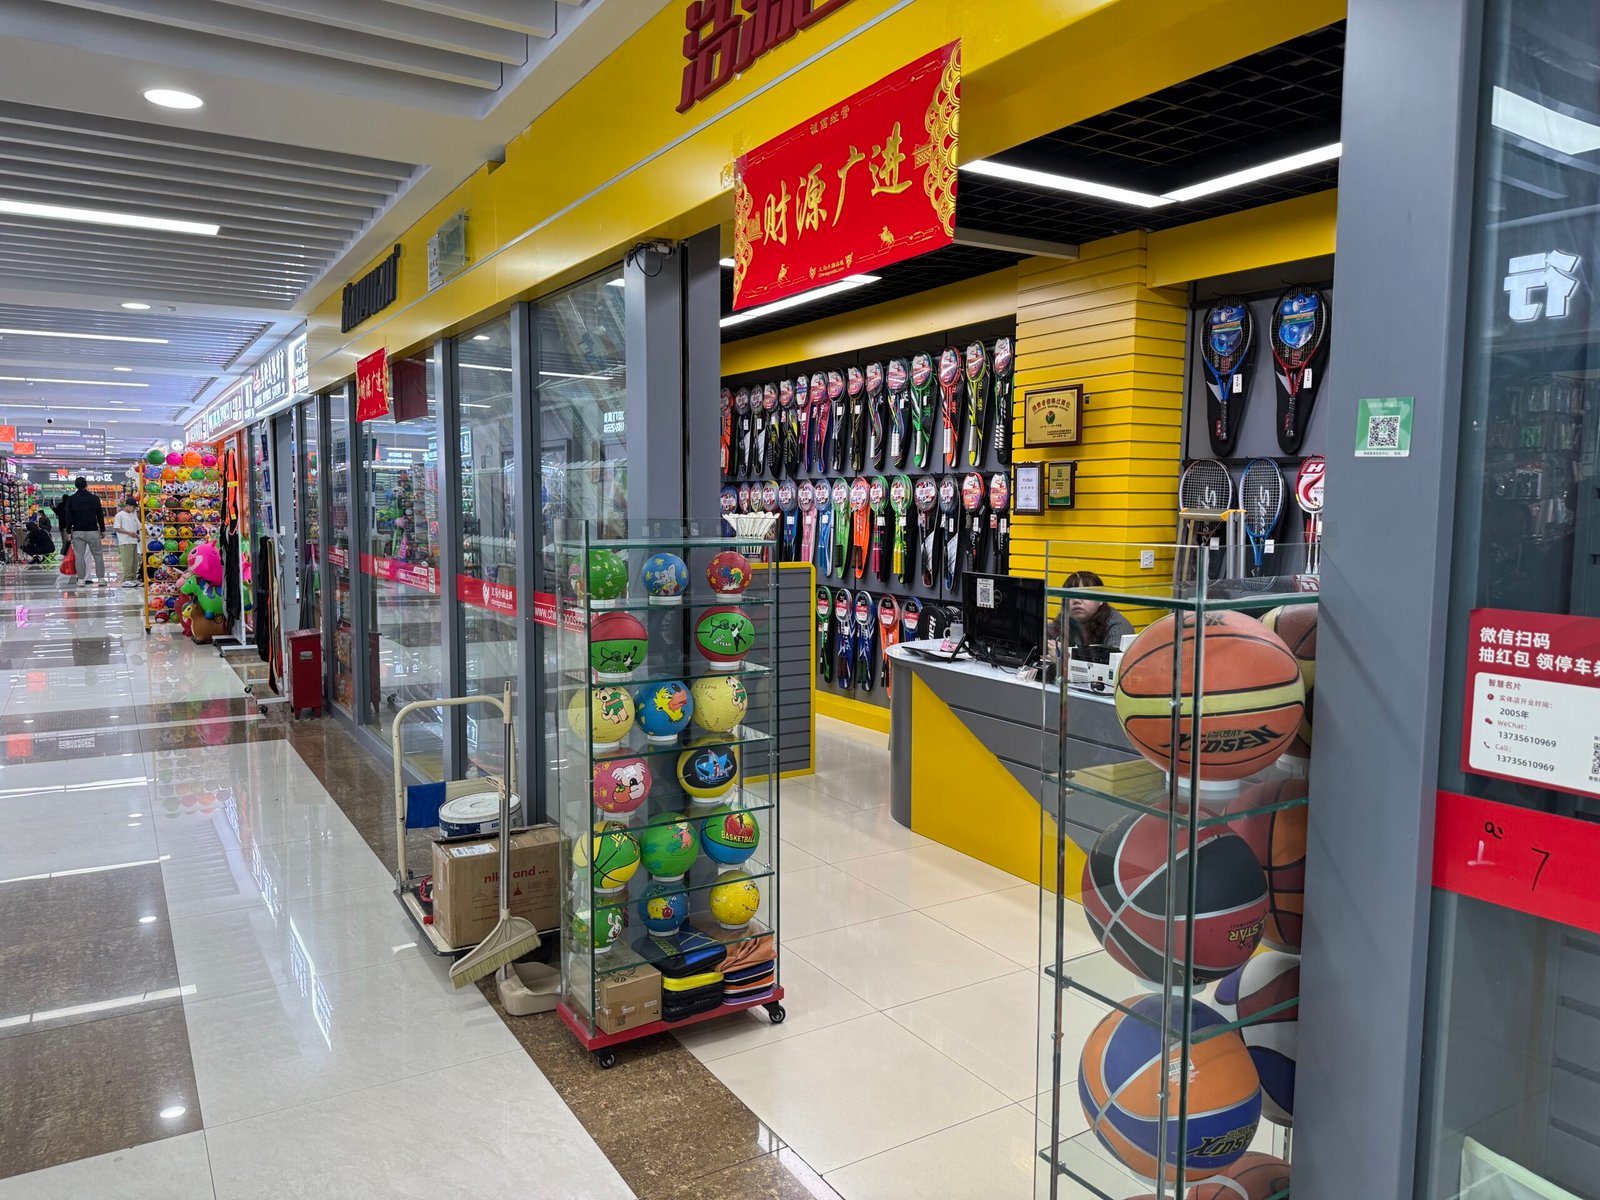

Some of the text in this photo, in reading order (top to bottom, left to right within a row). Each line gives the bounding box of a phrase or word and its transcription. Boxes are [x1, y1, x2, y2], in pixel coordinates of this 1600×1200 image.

[809, 105, 851, 136] 诚信经营
[762, 121, 913, 246] 财源广进
[1480, 626, 1550, 650] 微信扫码
[1478, 646, 1530, 668] 抽红包
[1488, 678, 1522, 691] 智慧名片
[1499, 707, 1529, 719] 2005年
[1498, 731, 1557, 748] 13735610969
[1496, 754, 1555, 772] 13735610969
[512, 866, 536, 879] and
